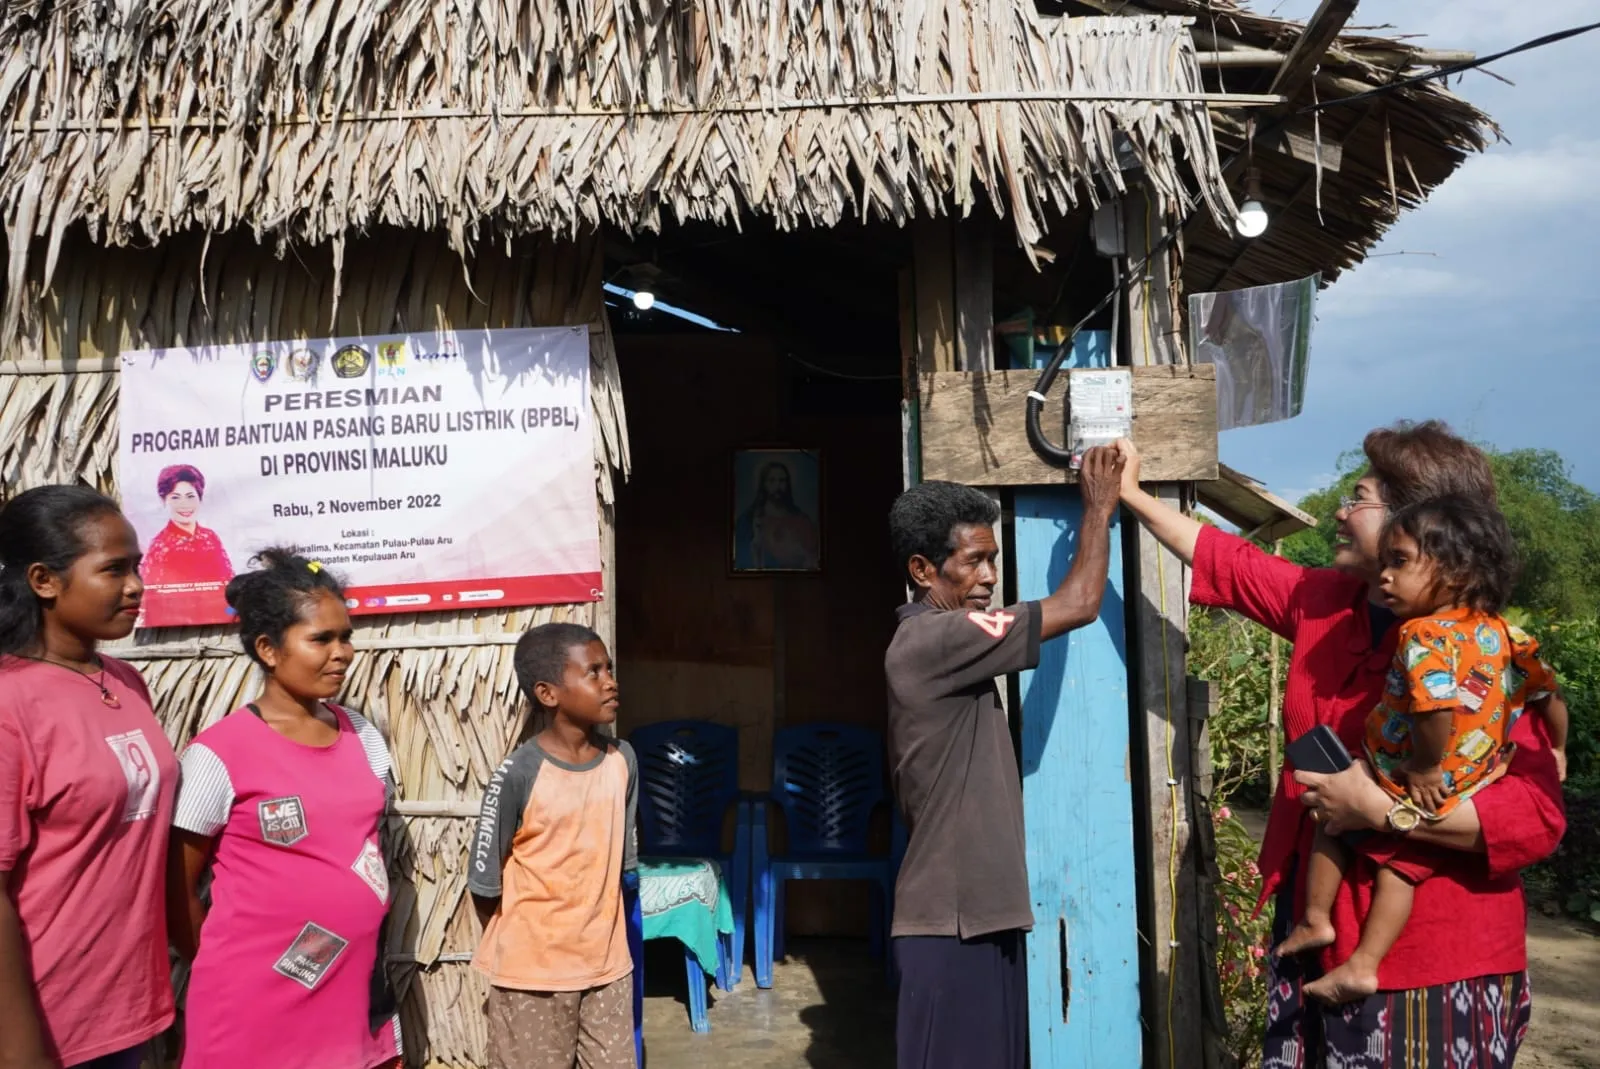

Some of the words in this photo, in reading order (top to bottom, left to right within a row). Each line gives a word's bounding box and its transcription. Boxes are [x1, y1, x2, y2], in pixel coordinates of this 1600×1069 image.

[378, 367, 406, 377] PLN
[264, 385, 442, 412] PERESMIAN
[131, 427, 219, 454] PROGRAM
[225, 420, 307, 447] BANTUAN
[313, 415, 385, 440] PASANG
[391, 412, 441, 435] BARU
[446, 409, 515, 433] LISTRIK
[521, 405, 580, 434] (BPBL)
[261, 454, 278, 477] DI
[284, 448, 367, 475] PROVINSI
[373, 444, 448, 469] MALUKU
[273, 502, 313, 518] Rabu,
[317, 501, 326, 515] 2
[330, 497, 403, 514] November
[407, 494, 442, 509] 2022
[333, 540, 380, 552] Kecamatan
[382, 536, 435, 548] Pulau-Pulau
[436, 535, 453, 546] Aru
[341, 528, 369, 539] Lokasi
[352, 552, 398, 564] Kepulauan
[400, 550, 416, 561] Aru
[966, 610, 1015, 638] 4
[475, 758, 514, 873] MARSHMELLO
